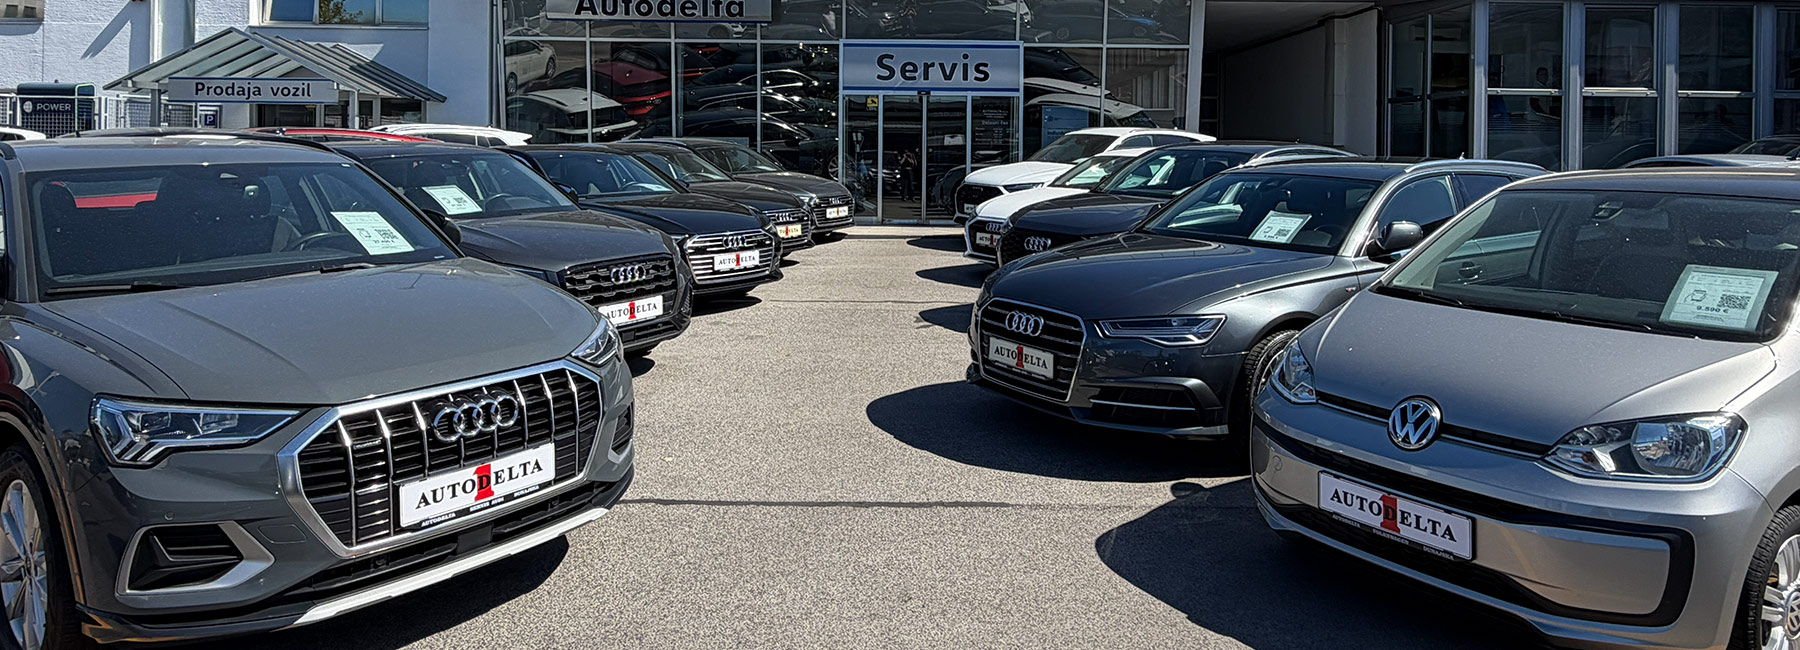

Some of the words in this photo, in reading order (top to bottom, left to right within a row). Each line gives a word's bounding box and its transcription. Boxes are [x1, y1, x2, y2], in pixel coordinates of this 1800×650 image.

[875, 53, 990, 82] Servis
[195, 81, 262, 100] Prodaja
[270, 82, 311, 98] vozil
[36, 103, 72, 111] POWER
[206, 115, 214, 124] P
[415, 458, 544, 510] AUTODELTA
[1330, 487, 1457, 543] AUTODELTA
